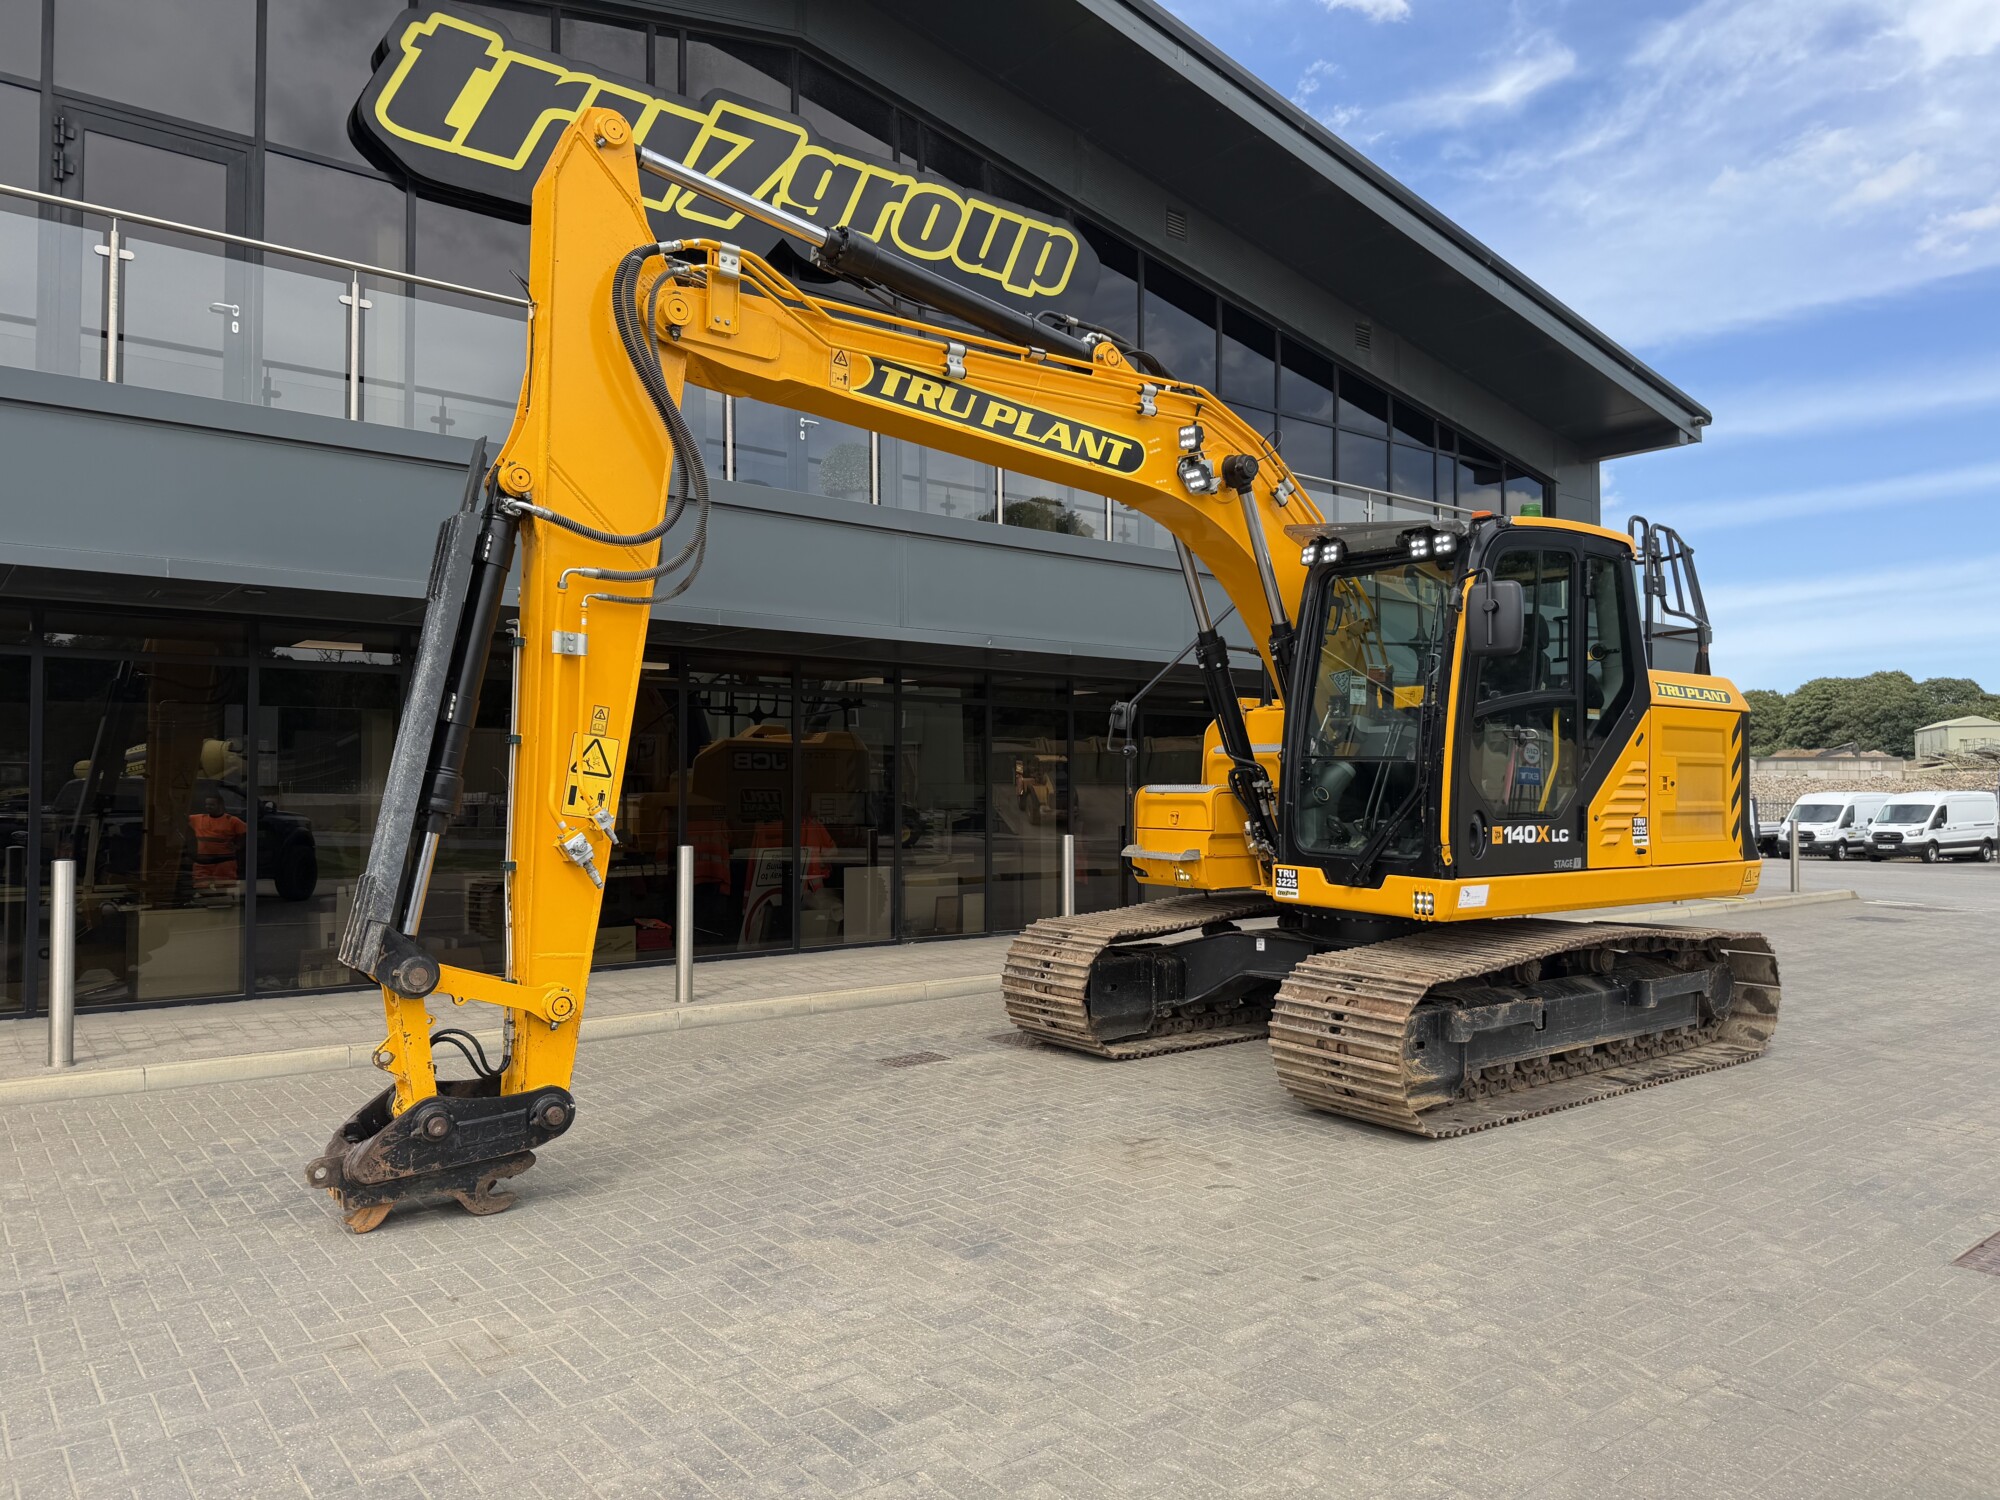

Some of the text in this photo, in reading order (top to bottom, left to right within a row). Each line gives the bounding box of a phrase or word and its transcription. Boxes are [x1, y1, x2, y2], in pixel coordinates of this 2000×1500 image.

[879, 365, 1133, 466] TRU PLANT
[1657, 683, 1726, 702] TRU PLANT
[1633, 817, 1646, 826] TRU
[1503, 825, 1550, 844] 140X
[1551, 829, 1569, 843] LC
[1632, 826, 1647, 835] 3225
[1553, 859, 1573, 869] STAGE
[1277, 868, 1296, 878] TRU
[1276, 877, 1297, 888] 3225
